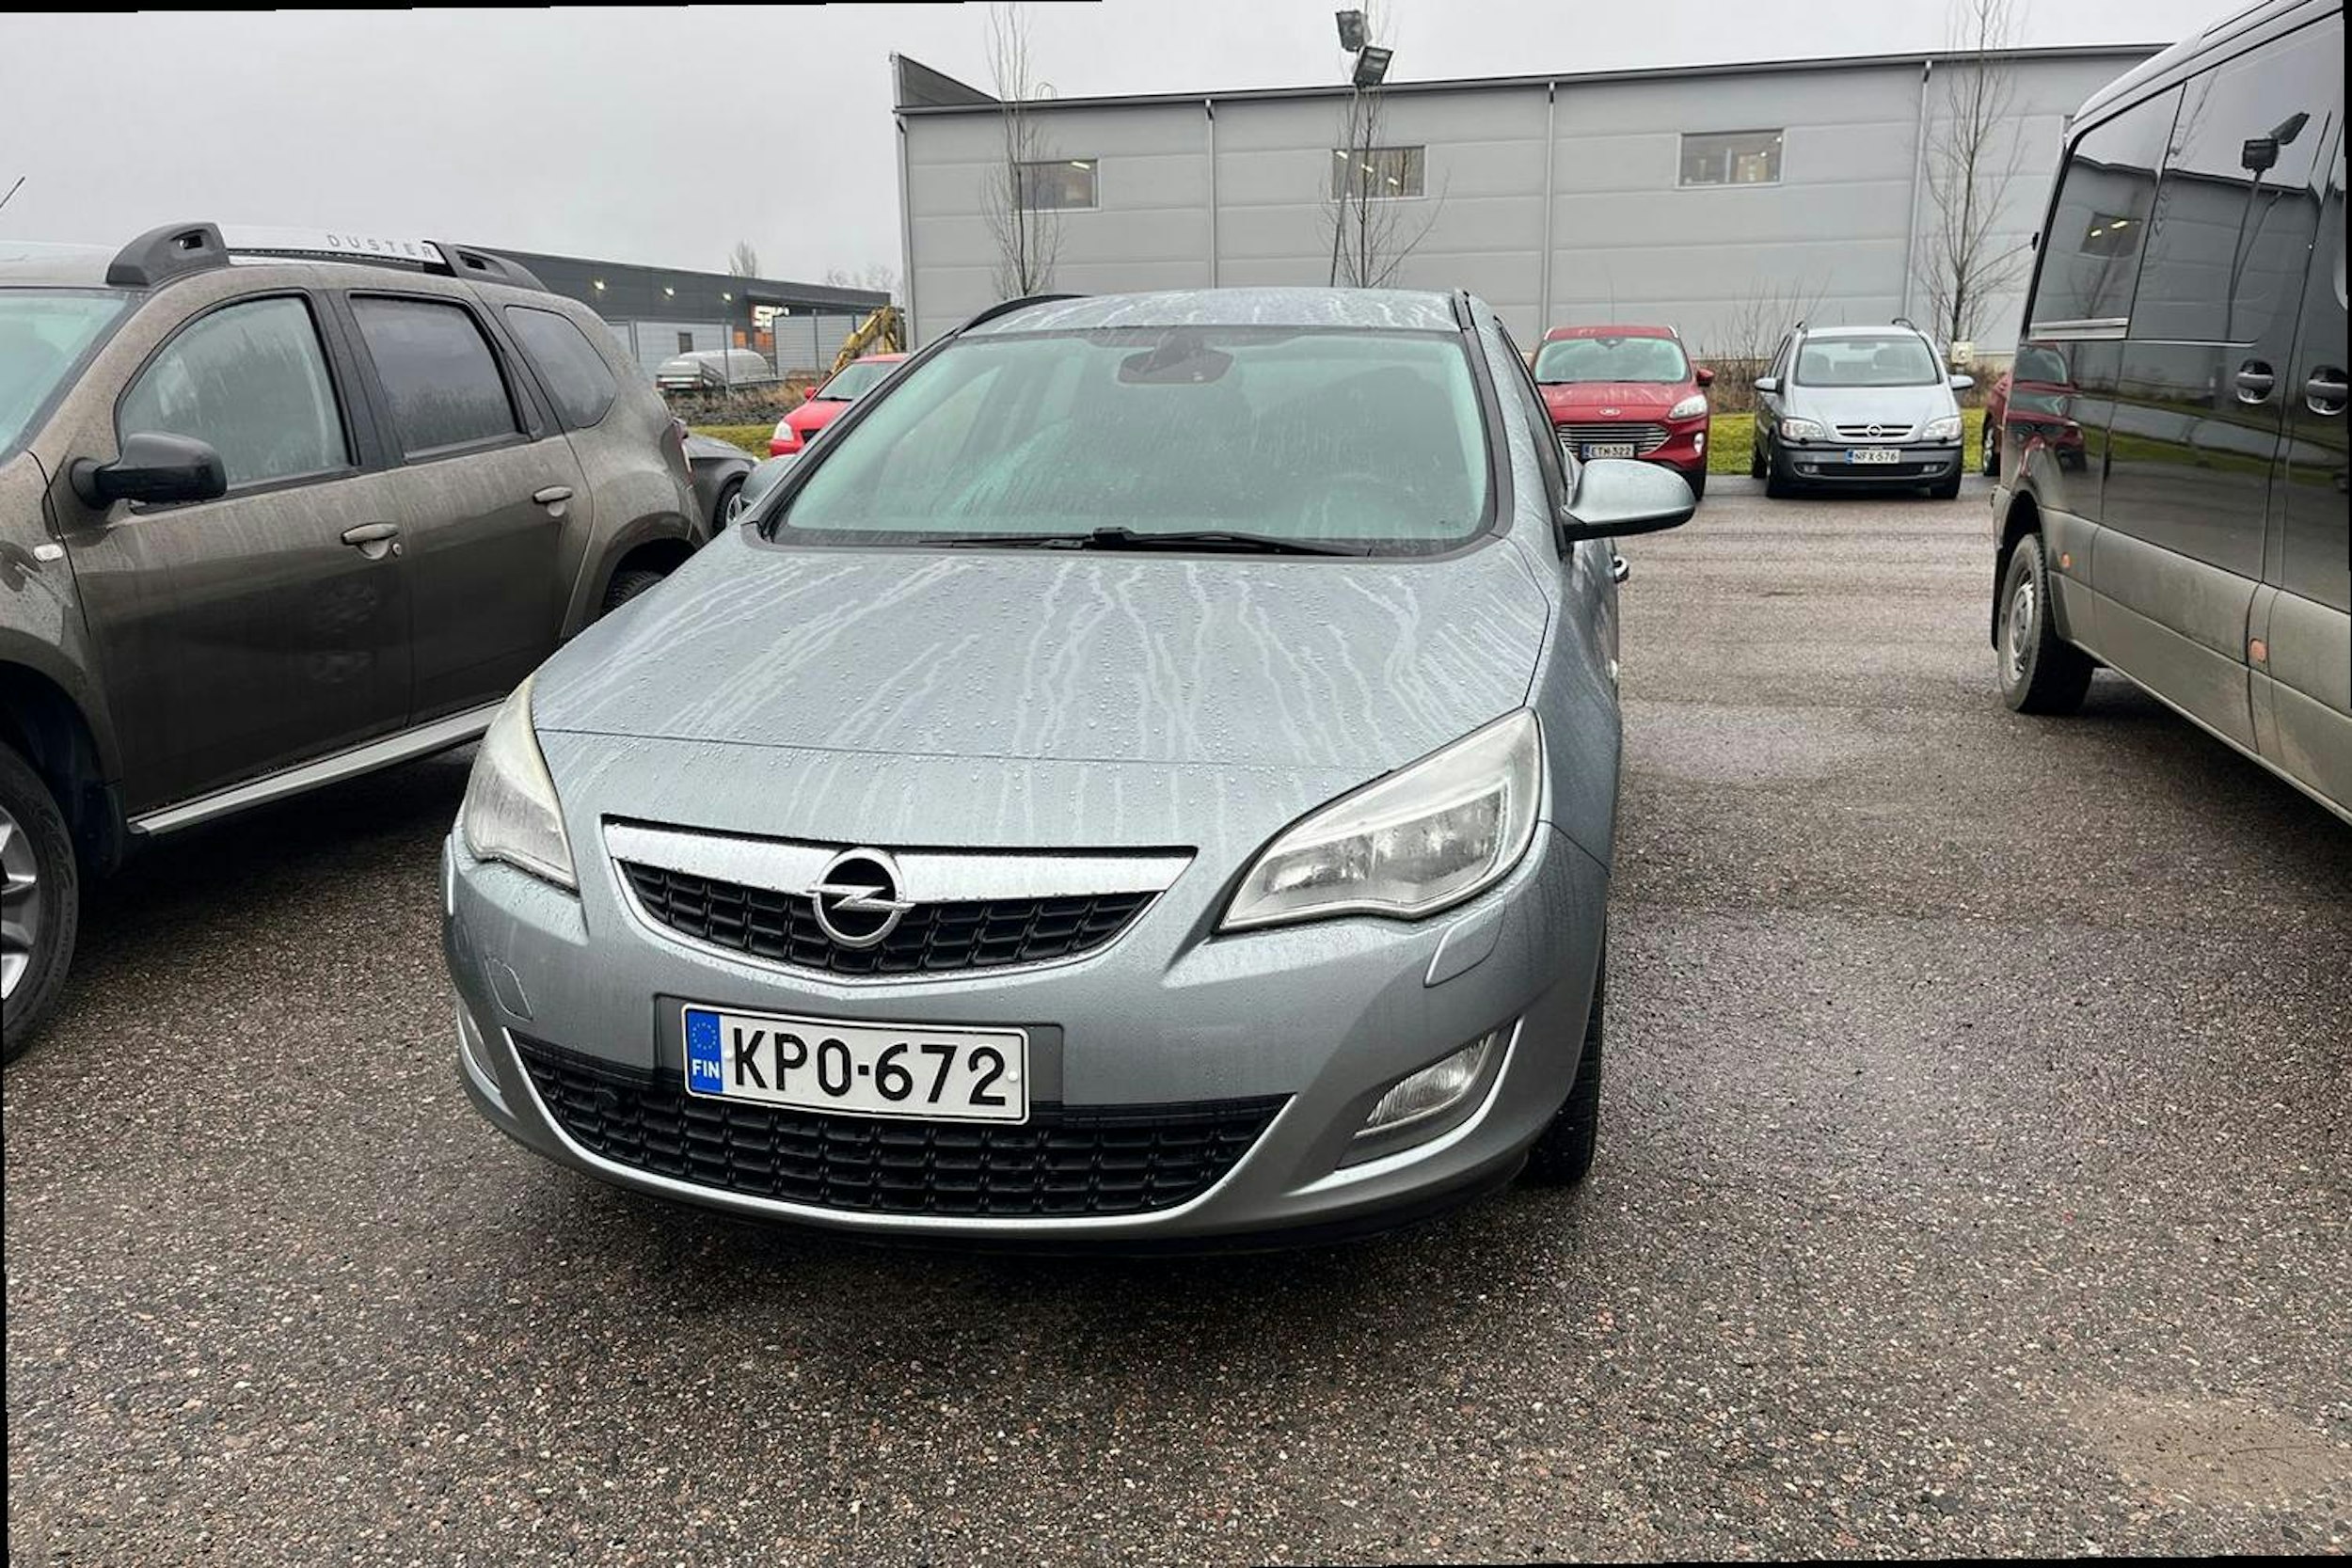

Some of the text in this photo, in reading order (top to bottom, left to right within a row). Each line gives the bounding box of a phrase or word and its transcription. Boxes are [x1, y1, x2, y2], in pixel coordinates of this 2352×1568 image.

[326, 233, 435, 259] DUSTER
[691, 1027, 1007, 1106] FIN KPO-672
